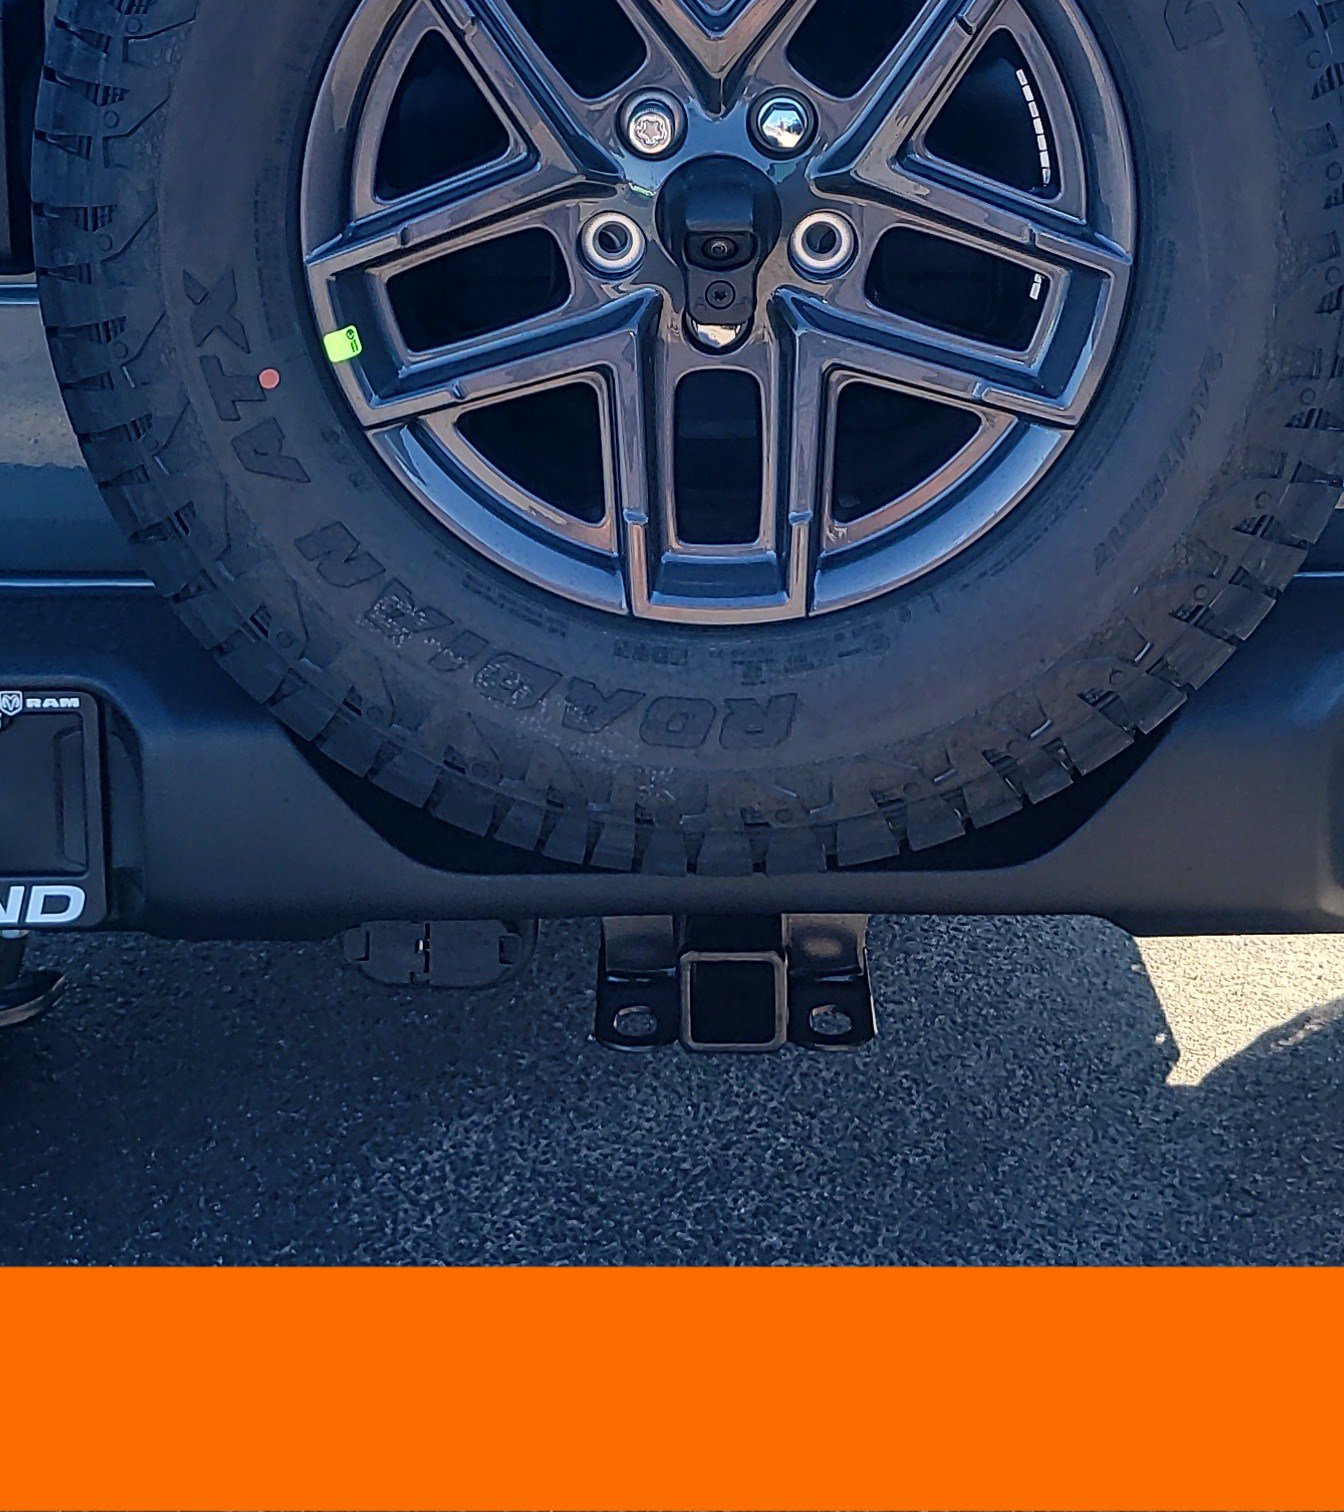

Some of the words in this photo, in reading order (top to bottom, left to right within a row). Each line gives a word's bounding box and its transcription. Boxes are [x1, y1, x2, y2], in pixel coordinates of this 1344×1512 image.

[181, 267, 312, 484] ATX
[25, 697, 80, 709] RAM
[293, 520, 799, 751] ROADIAN
